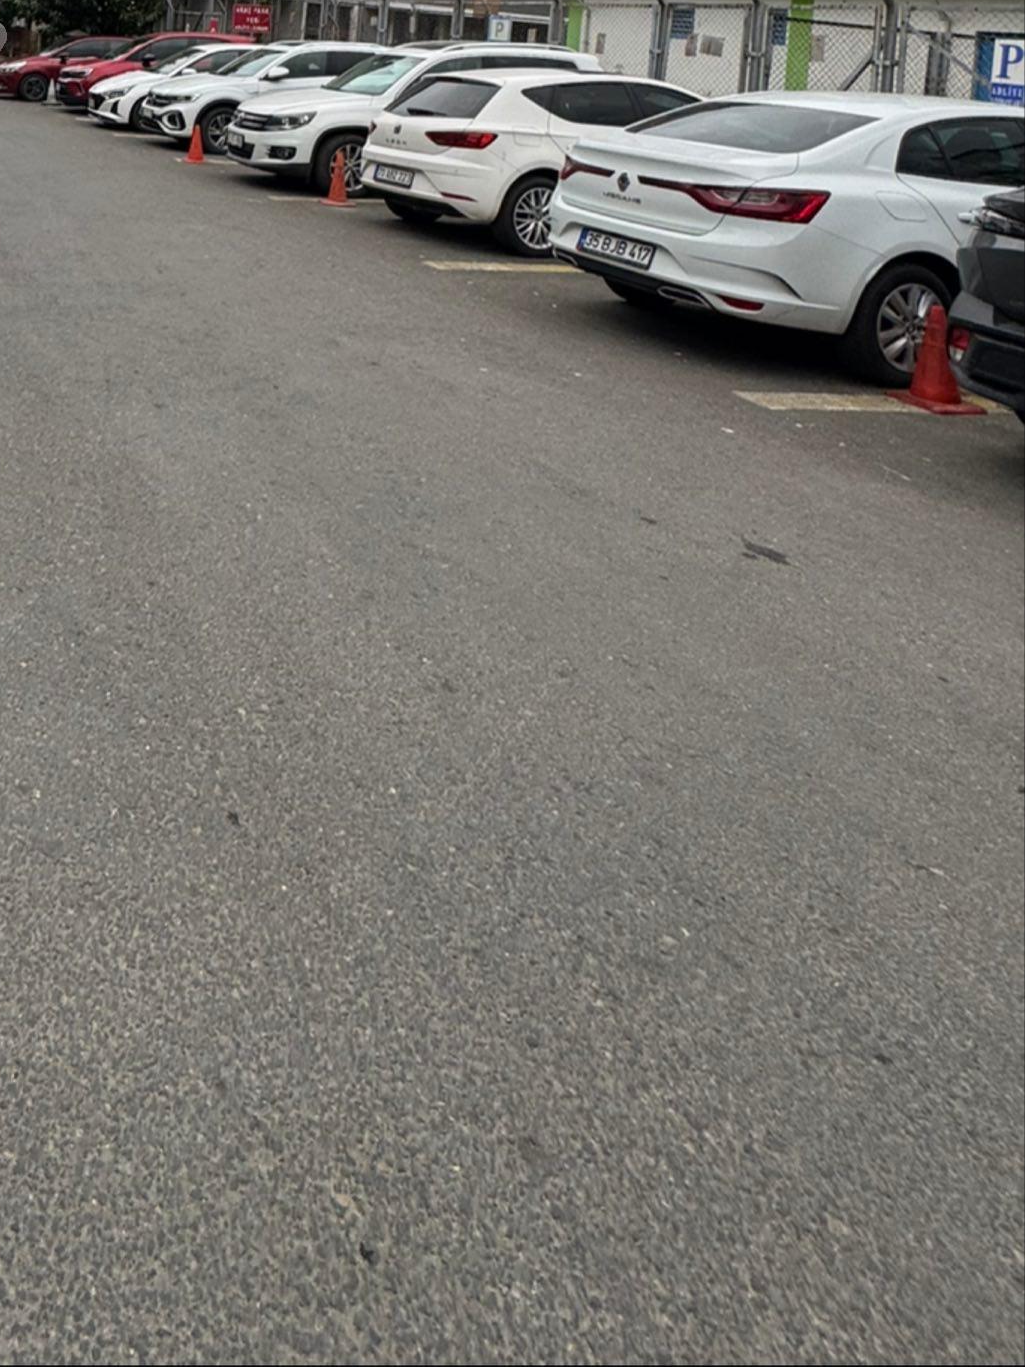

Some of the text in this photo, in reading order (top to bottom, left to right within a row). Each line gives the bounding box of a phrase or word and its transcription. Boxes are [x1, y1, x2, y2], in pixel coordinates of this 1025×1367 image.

[495, 21, 505, 38] P
[996, 43, 1024, 80] P
[586, 232, 652, 262] 35 BJB 417
